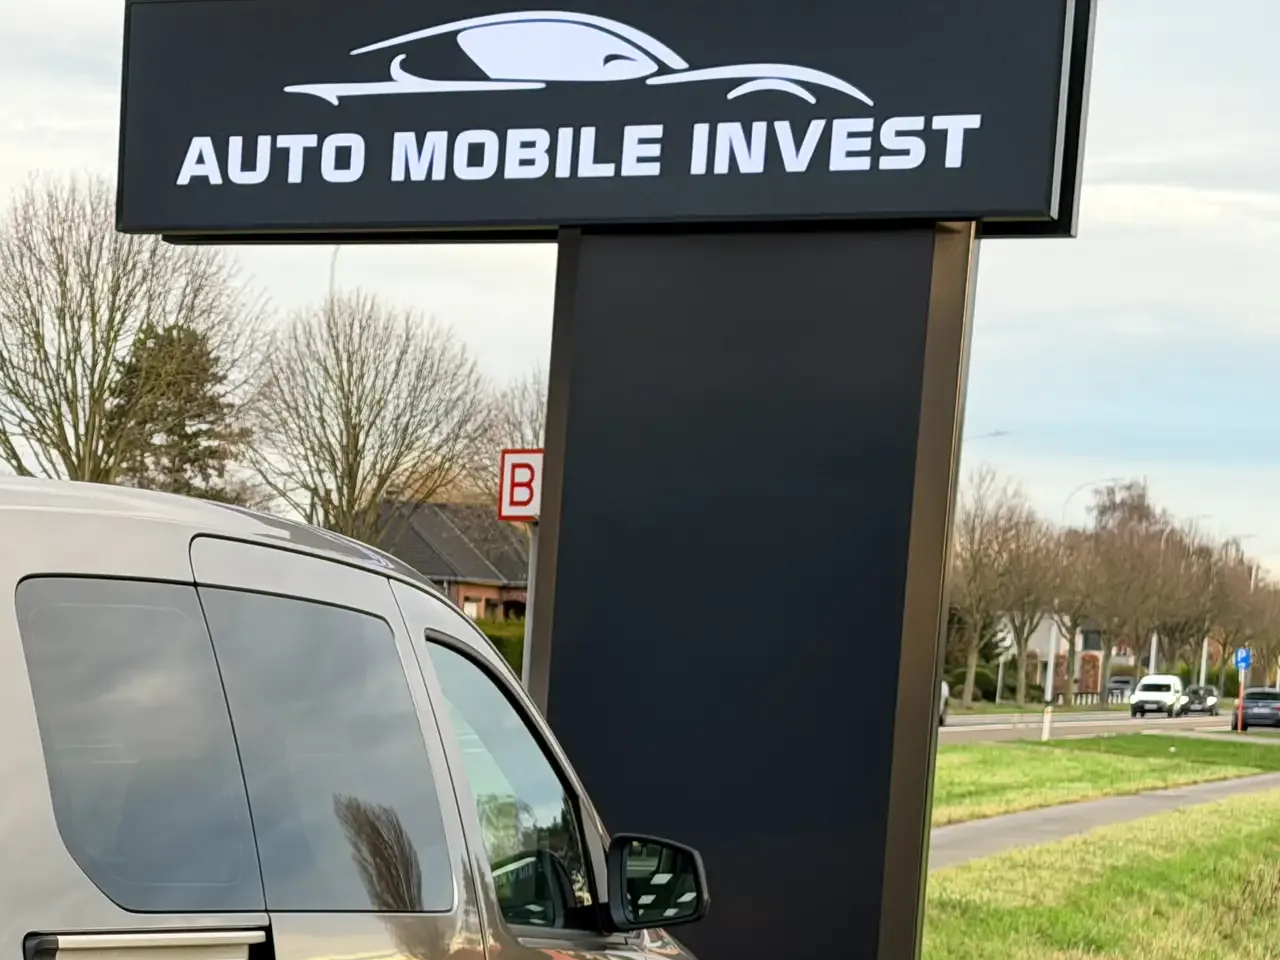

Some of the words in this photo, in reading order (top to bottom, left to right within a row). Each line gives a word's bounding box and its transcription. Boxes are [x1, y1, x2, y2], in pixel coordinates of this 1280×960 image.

[176, 133, 366, 186] AUTO
[390, 124, 664, 182] MOBILE
[690, 114, 982, 175] INVEST
[508, 462, 535, 507] B
